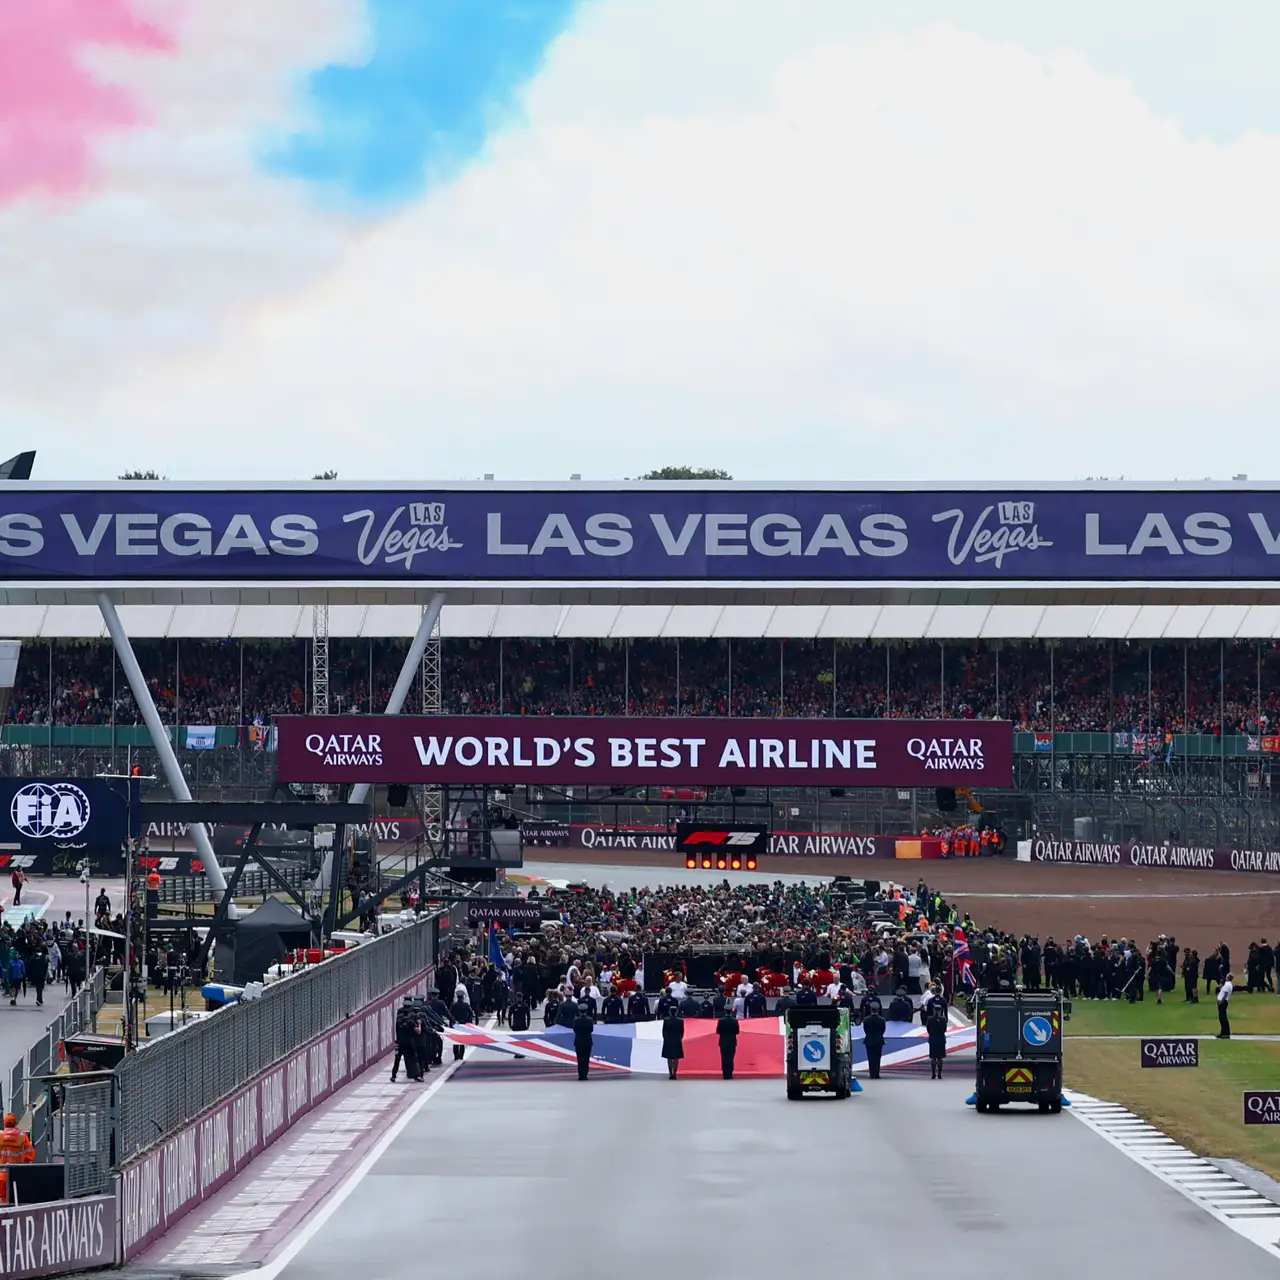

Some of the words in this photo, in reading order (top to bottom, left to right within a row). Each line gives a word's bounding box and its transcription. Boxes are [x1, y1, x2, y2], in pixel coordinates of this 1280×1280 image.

[413, 504, 442, 523] LAS
[1001, 503, 1031, 522] LAS
[60, 513, 318, 556] VEGAS
[343, 507, 463, 570] Vegas
[487, 513, 633, 556] LAS
[650, 514, 908, 556] VEGAS
[932, 506, 1053, 569] Vegas
[1086, 512, 1232, 555] LAS
[305, 734, 382, 757] QATAR
[608, 738, 706, 768] BEST
[719, 738, 877, 769] AIRLINE
[906, 738, 984, 761] QATAR
[323, 754, 383, 766] AIRWAYS
[925, 758, 985, 770] AIRWAYS
[768, 835, 799, 854] TAR
[804, 836, 876, 856] AIRWAYS
[1035, 840, 1072, 861] QATAR
[1074, 842, 1121, 863] AIRWAYS
[1130, 845, 1167, 866] QATAR
[1169, 846, 1215, 868] AIRWAYS
[1230, 849, 1263, 871] QATAR
[470, 908, 500, 917] QATAR
[502, 909, 540, 918] AIRWAYS
[1144, 1042, 1196, 1058] QATAR
[1156, 1055, 1197, 1065] AIRWAYS
[40, 1203, 105, 1267] AIRWAYS
